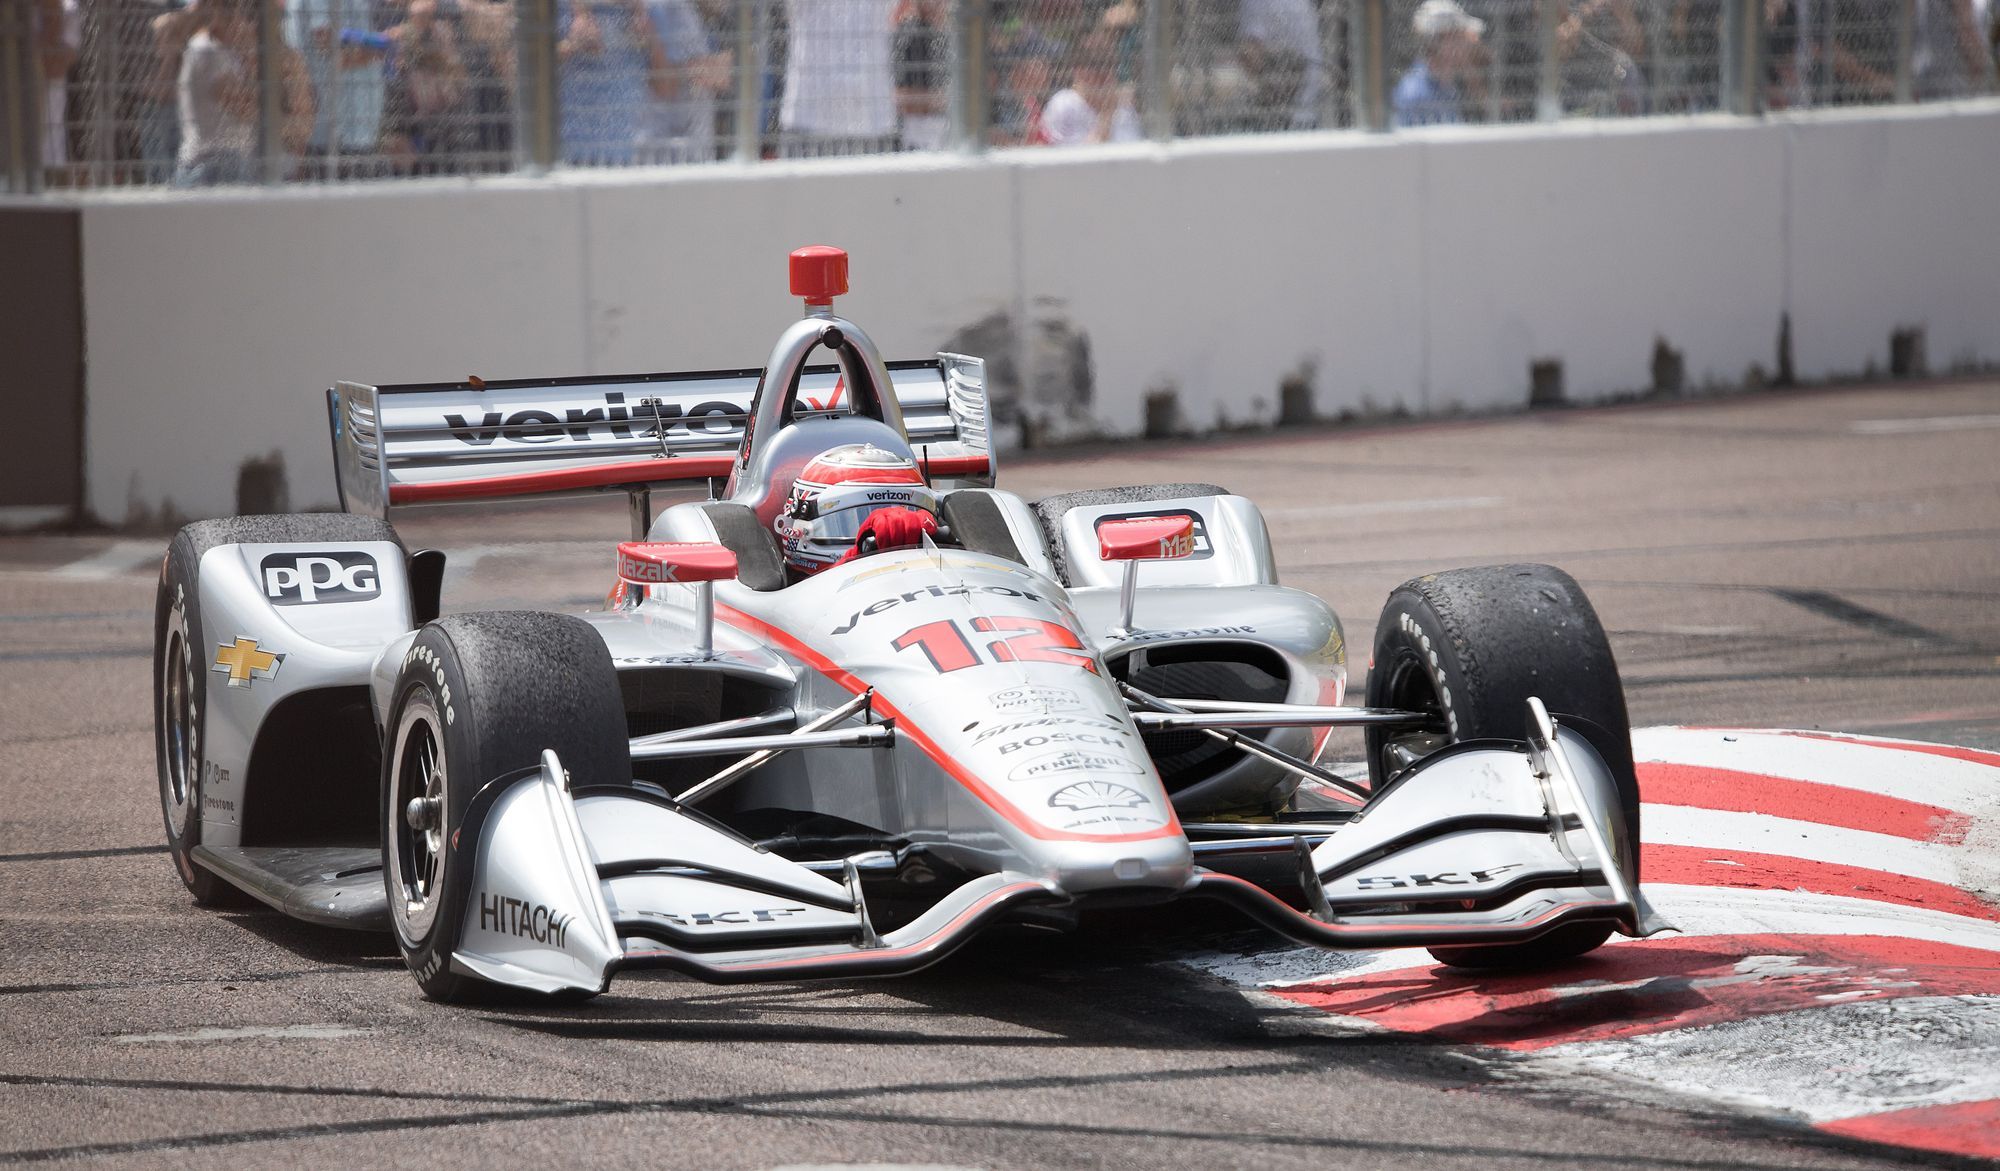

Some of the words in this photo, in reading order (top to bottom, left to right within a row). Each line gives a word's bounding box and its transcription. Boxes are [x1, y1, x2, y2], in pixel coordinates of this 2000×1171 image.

[443, 391, 807, 446] verizo
[867, 490, 911, 501] verizon
[265, 557, 377, 602] PPG
[890, 615, 1101, 677] 12
[999, 732, 1126, 755] BOSCH
[1026, 757, 1124, 776] PENNZOIL
[1356, 863, 1524, 890] SKF
[480, 891, 576, 950] HITACHI
